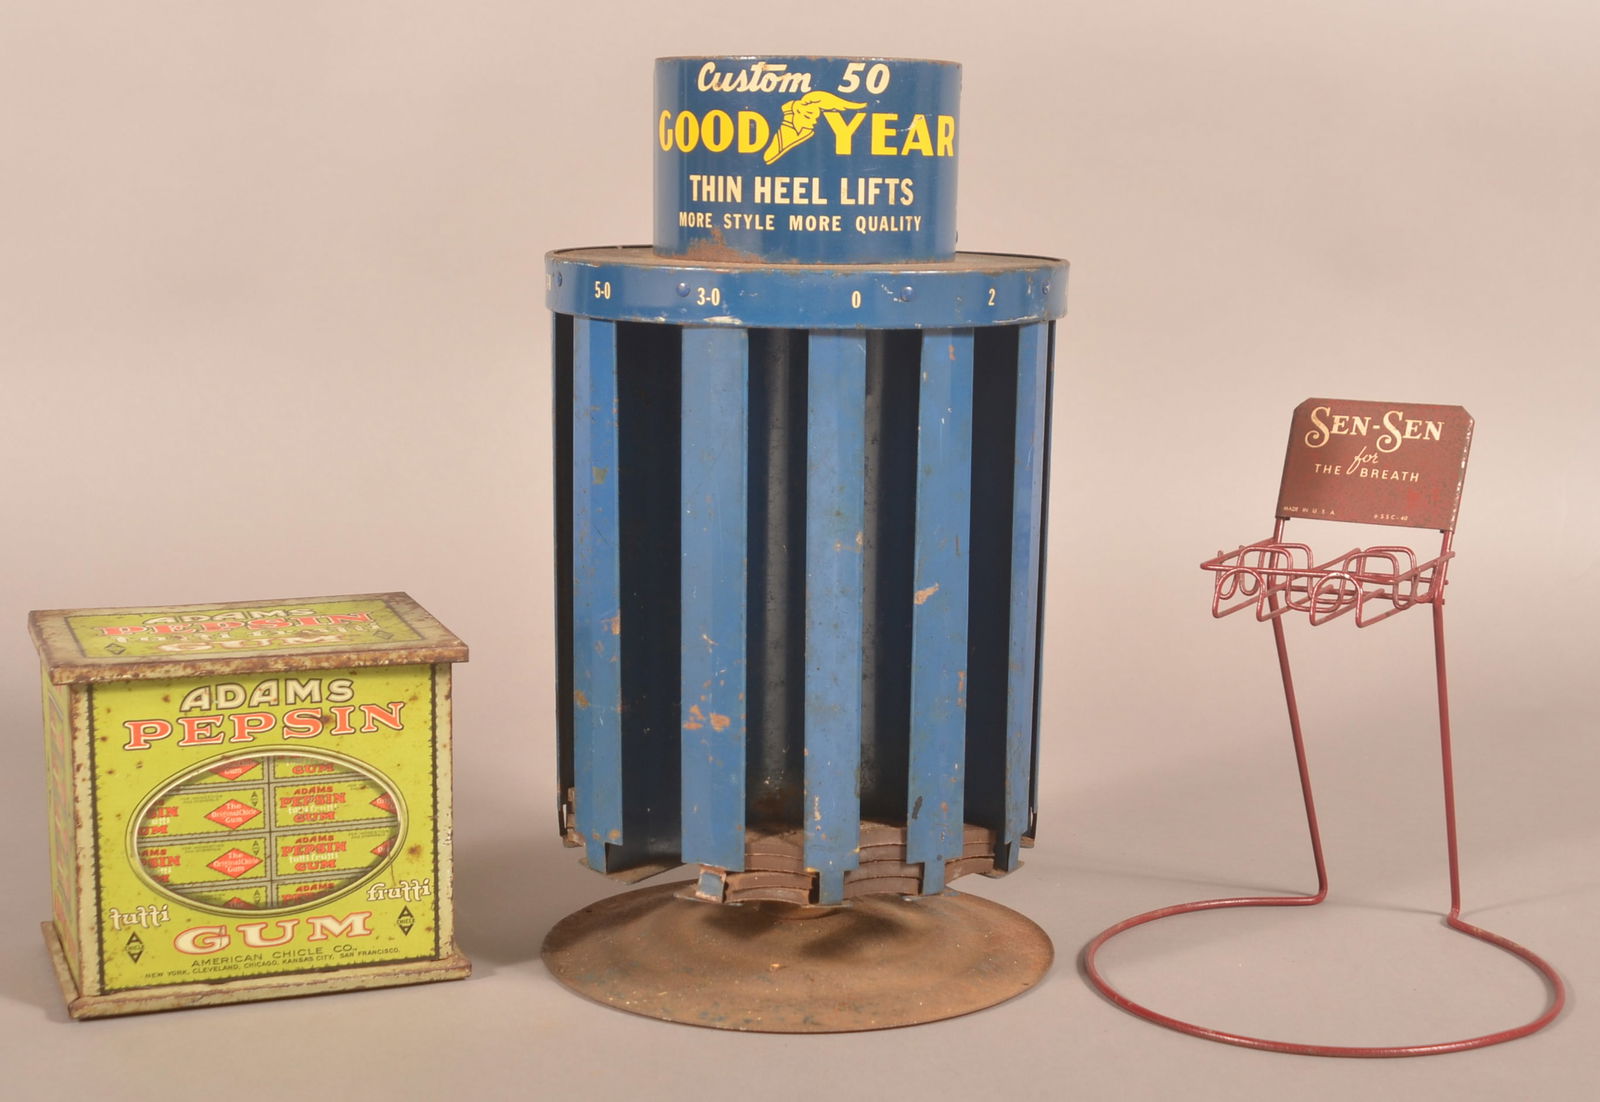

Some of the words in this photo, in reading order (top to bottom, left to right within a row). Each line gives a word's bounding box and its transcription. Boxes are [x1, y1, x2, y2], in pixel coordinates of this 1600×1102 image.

[697, 61, 812, 93] Custom
[837, 62, 891, 95] 50
[658, 109, 770, 153] GOOD
[823, 111, 956, 157] YEAR
[689, 174, 743, 203] THIN
[754, 177, 827, 205] HEEL
[840, 177, 914, 206] LIFTS
[679, 211, 713, 228] MORE
[723, 213, 775, 231] STYLE
[789, 215, 842, 232] MORE
[855, 215, 922, 234] QUALITY
[594, 280, 612, 300] 5-0
[697, 287, 721, 307] 3-0
[851, 290, 862, 309] 0
[987, 287, 996, 306] 2
[1346, 446, 1379, 475] for
[1314, 463, 1342, 476] THE
[1360, 467, 1420, 482] BREATH
[100, 612, 375, 637] PEPSIN
[143, 609, 317, 626] ADAMS
[157, 634, 348, 652] GUM
[179, 678, 355, 713] ADAMS
[123, 701, 406, 751] PEPSIN
[292, 763, 335, 775] GUM
[280, 792, 347, 808] PEPSIN
[294, 786, 334, 795] ADAMS
[293, 811, 336, 823] GUM
[281, 841, 347, 857] PEPSIN
[295, 835, 335, 844] ADAMS
[294, 859, 337, 872] GUM
[367, 877, 432, 903] frutti
[109, 904, 171, 931] tutti
[173, 911, 373, 955] GUM
[191, 953, 263, 967] AMERICAN
[271, 946, 324, 959] CHICLE
[282, 956, 314, 965] KANSAS
[339, 951, 355, 959] SAN
